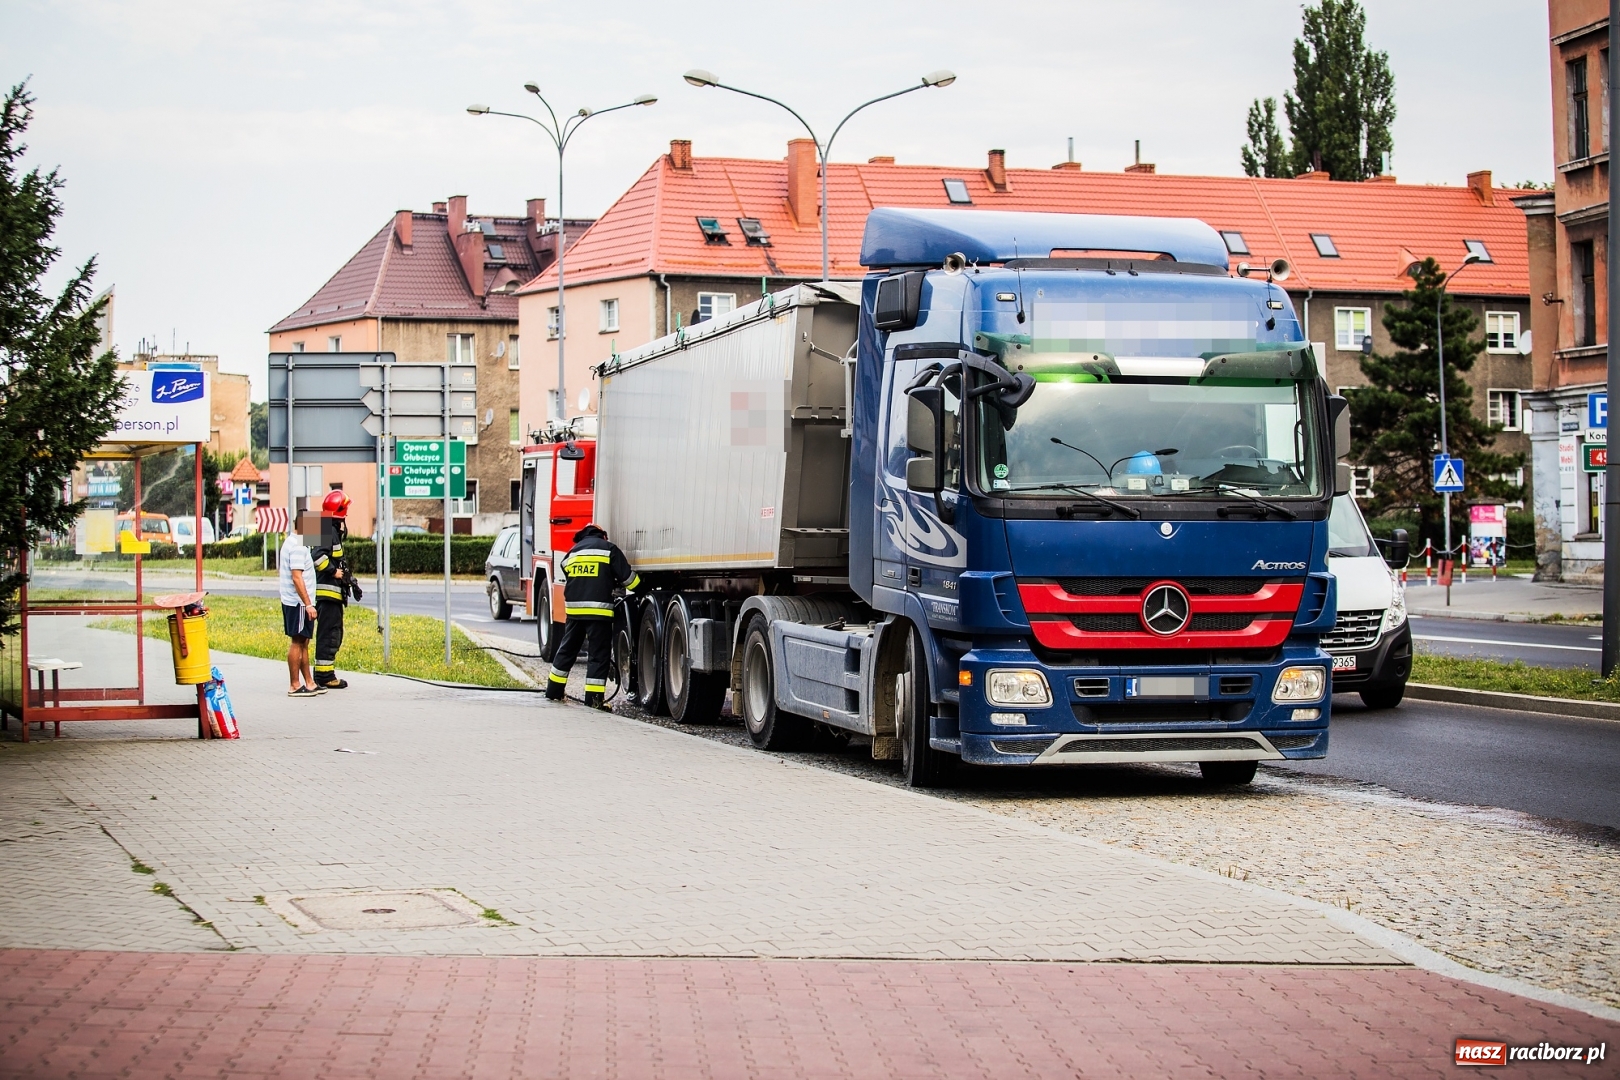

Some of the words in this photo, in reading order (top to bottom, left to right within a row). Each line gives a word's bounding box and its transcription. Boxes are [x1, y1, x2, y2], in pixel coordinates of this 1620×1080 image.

[403, 443, 428, 453] Opava
[403, 453, 440, 463] Głubczyce
[404, 466, 438, 476] Chałupki
[404, 476, 433, 485] Ostrava
[942, 580, 957, 590] 1841
